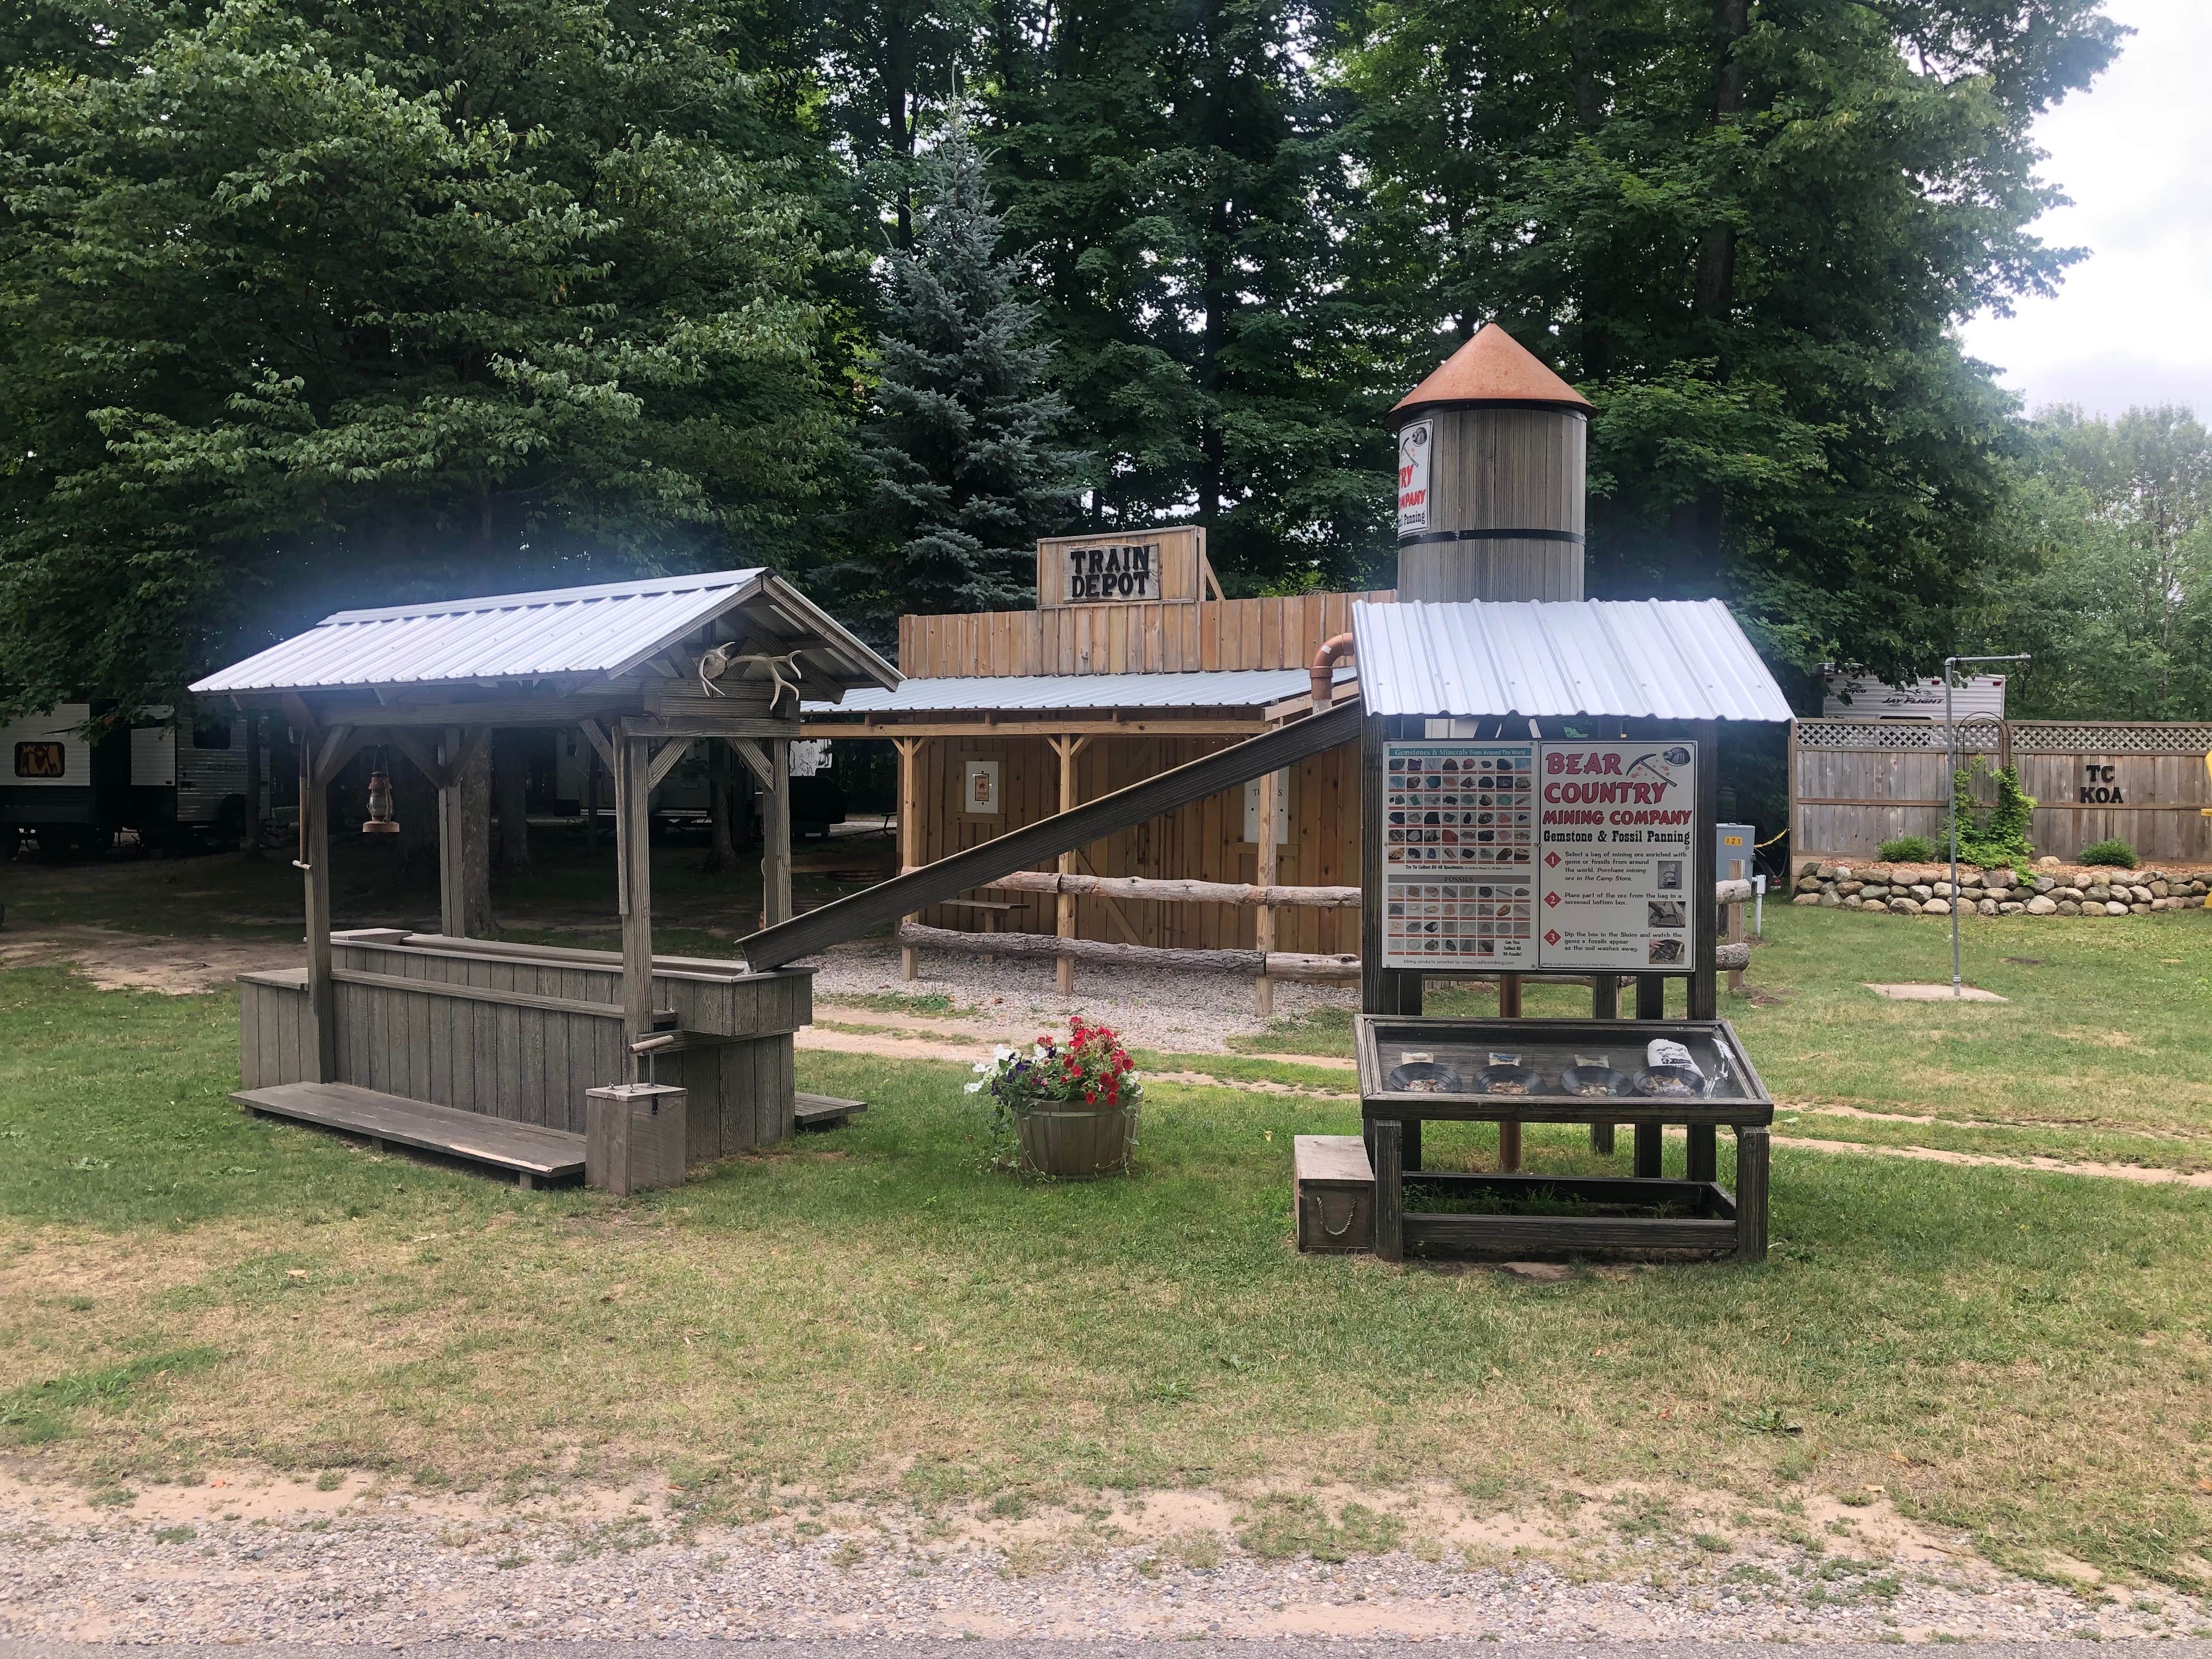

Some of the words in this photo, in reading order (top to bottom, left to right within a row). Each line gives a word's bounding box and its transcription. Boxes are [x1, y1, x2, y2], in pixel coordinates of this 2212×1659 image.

[1404, 511, 1425, 526] Panning
[1070, 545, 1149, 574] TRAIN
[1071, 571, 1149, 597] DEPOT
[1545, 753, 1622, 775] BEAR
[2086, 765, 2115, 783] TC
[1544, 781, 1667, 804] COUNTRY
[2080, 787, 2124, 803] KOA
[1543, 810, 1604, 825] MINING
[1610, 810, 1692, 825] COMPANY
[1544, 830, 1593, 842] Gemstone
[1598, 830, 1607, 842] &
[1612, 830, 1643, 842] Fossil
[1647, 831, 1690, 845] Panning
[1550, 896, 1555, 904] 2
[1549, 934, 1555, 942] 3
